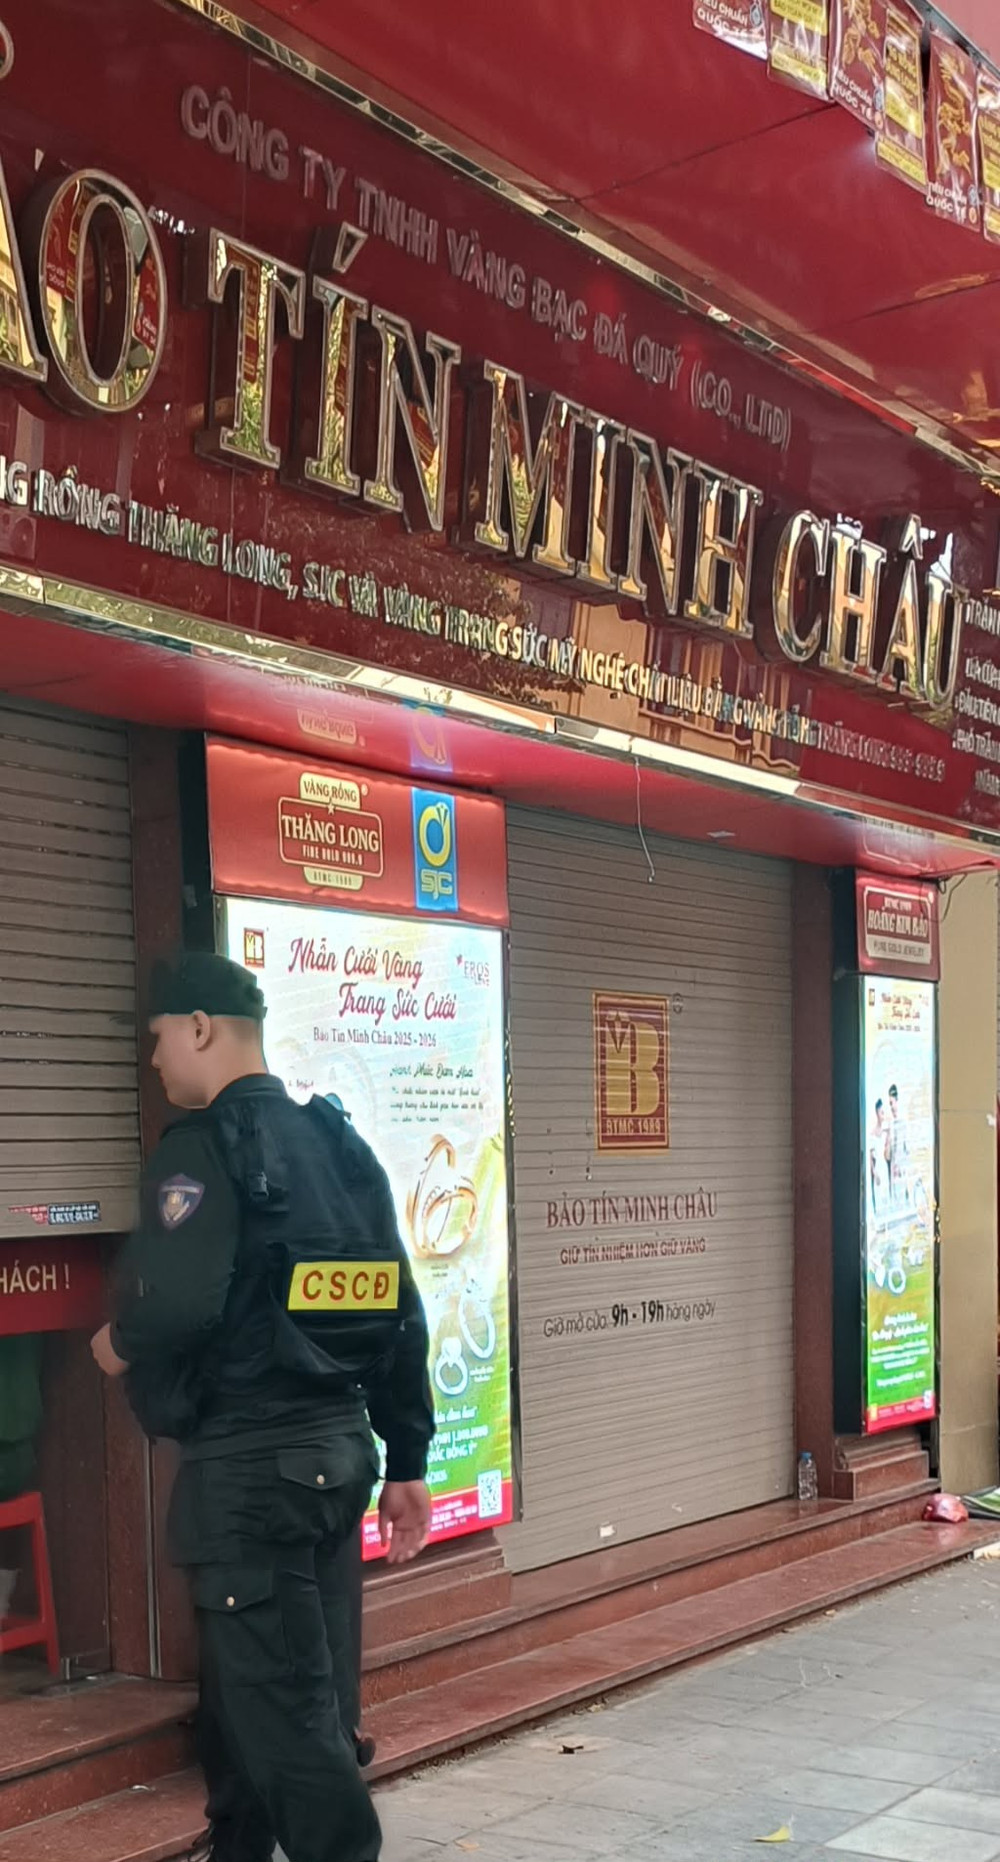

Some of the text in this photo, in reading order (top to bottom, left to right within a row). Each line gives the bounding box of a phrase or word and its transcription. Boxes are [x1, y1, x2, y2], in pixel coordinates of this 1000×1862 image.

[180, 84, 290, 181] CÔNG
[298, 144, 347, 211] TY
[354, 176, 439, 265] TNHH
[446, 227, 527, 310] VÀNG
[531, 276, 588, 343] BẠC
[594, 312, 629, 366] ĐÁ
[633, 333, 686, 391] QUÝ
[208, 221, 462, 532] TÍN
[474, 359, 763, 640] MINH
[772, 509, 969, 712] CHÂU
[32, 464, 121, 536] RỒNG
[125, 502, 219, 568] THĂNG
[303, 777, 330, 797] VÀNG
[281, 812, 379, 852] THĂNG LONG
[421, 868, 453, 900] SJC
[288, 936, 424, 990] Nhẫn Cưới Vàng
[338, 981, 458, 1026] Trang Sức Cưới
[546, 1186, 719, 1228] BẢO TÍN MINH CHÂU
[301, 1269, 391, 1302] CSCĐ
[611, 1303, 629, 1328] 9h
[641, 1300, 665, 1325] 19h
